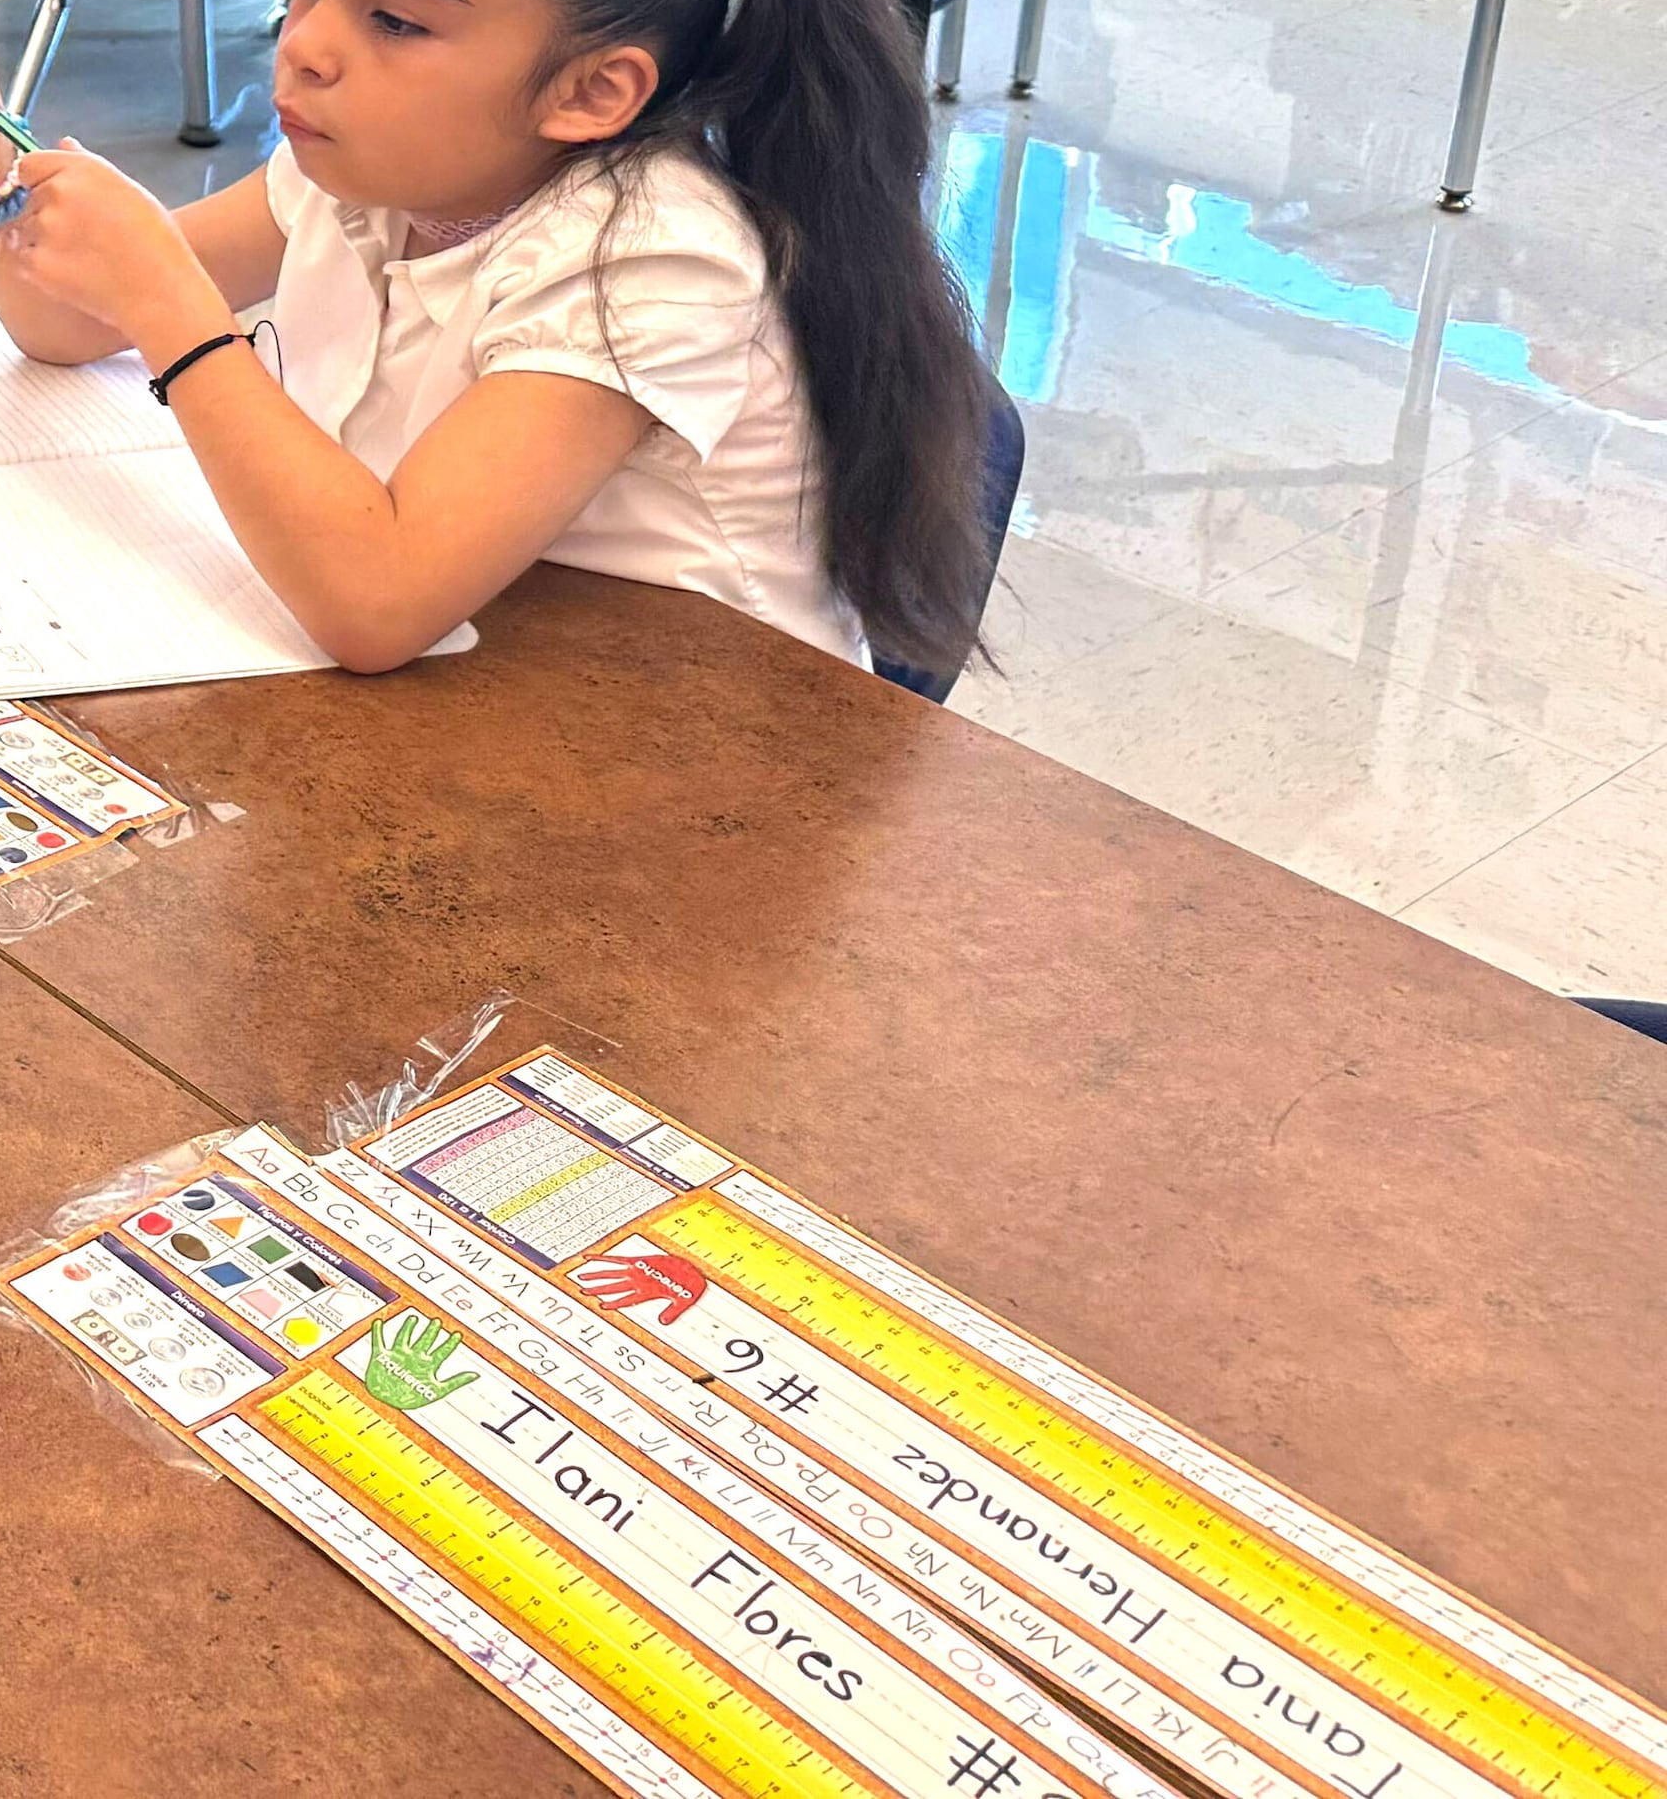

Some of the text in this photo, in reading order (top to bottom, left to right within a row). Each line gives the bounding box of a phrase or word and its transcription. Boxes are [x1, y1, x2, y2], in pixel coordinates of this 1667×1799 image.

[255, 1203, 296, 1237] Figuras
[300, 1229, 345, 1269] Colores
[632, 1258, 695, 1303] derecha
[169, 1288, 208, 1320] Dinero
[478, 1387, 863, 1706] Ilani Flores
[889, 1442, 1169, 1650] Hernandez
[1220, 1651, 1404, 1799] Tania
